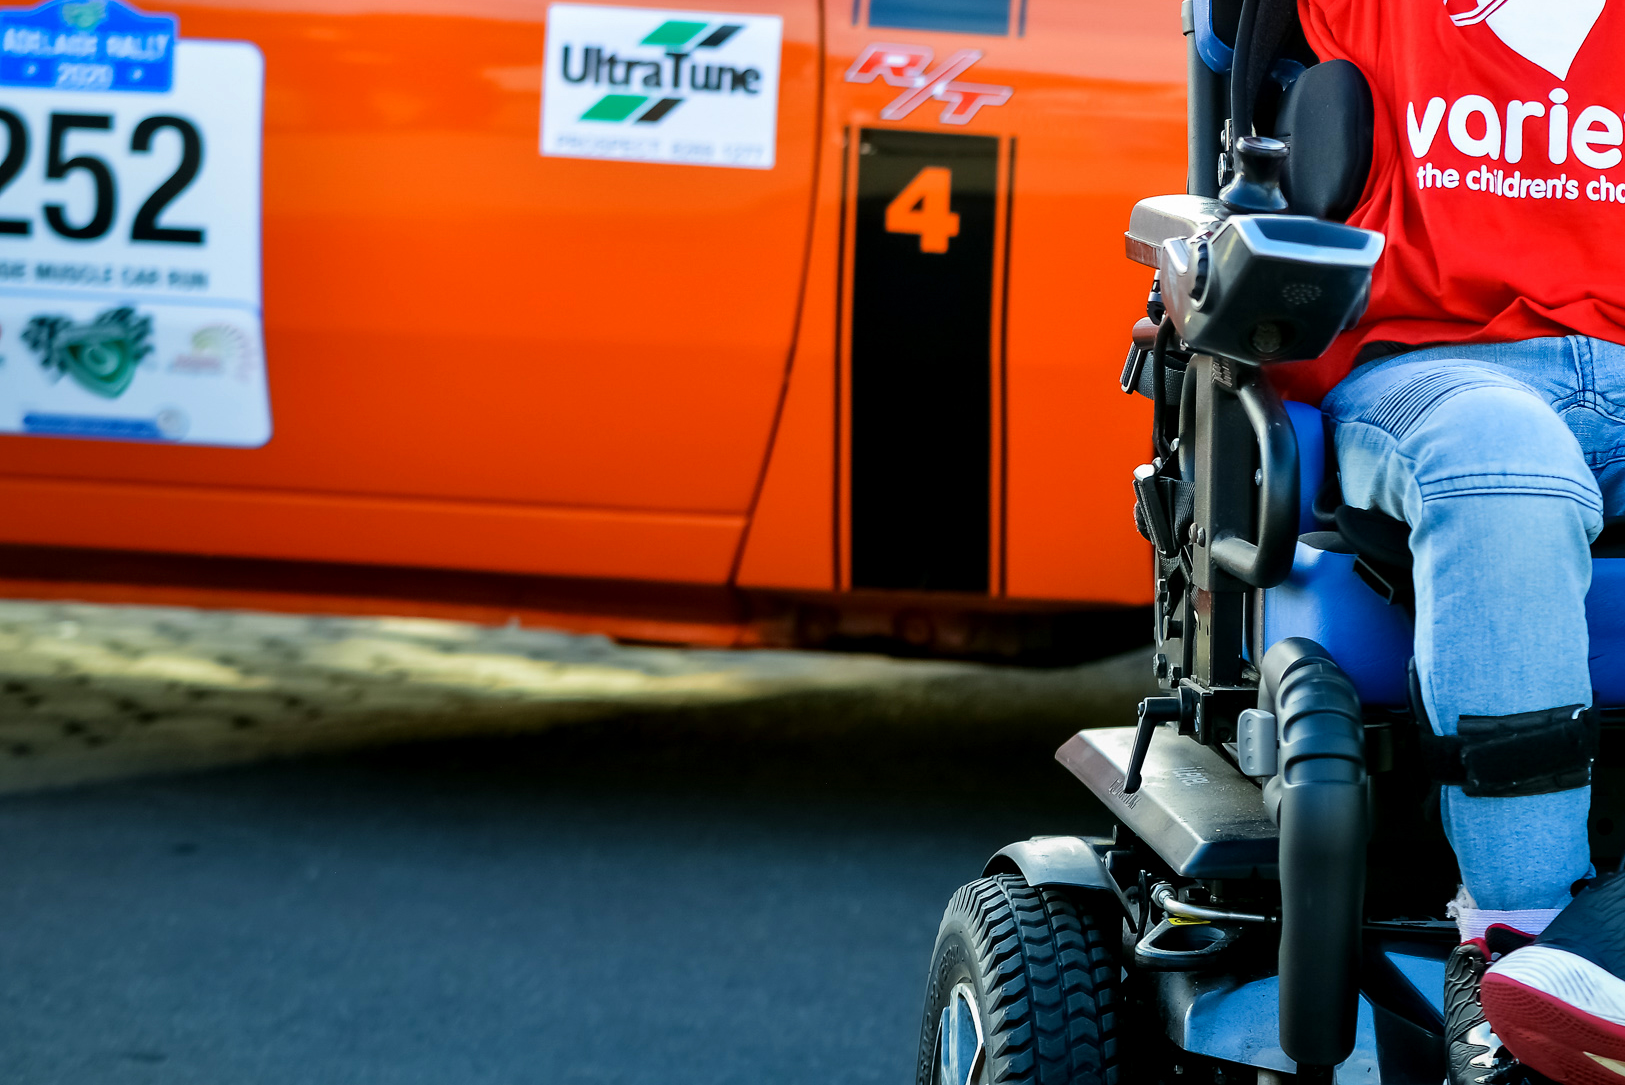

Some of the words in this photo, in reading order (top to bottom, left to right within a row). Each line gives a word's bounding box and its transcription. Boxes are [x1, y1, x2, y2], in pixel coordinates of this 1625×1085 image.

[845, 42, 1014, 125] R/T
[885, 166, 960, 254] 4
[1417, 163, 1459, 189] the
[1466, 165, 1578, 200] children's
